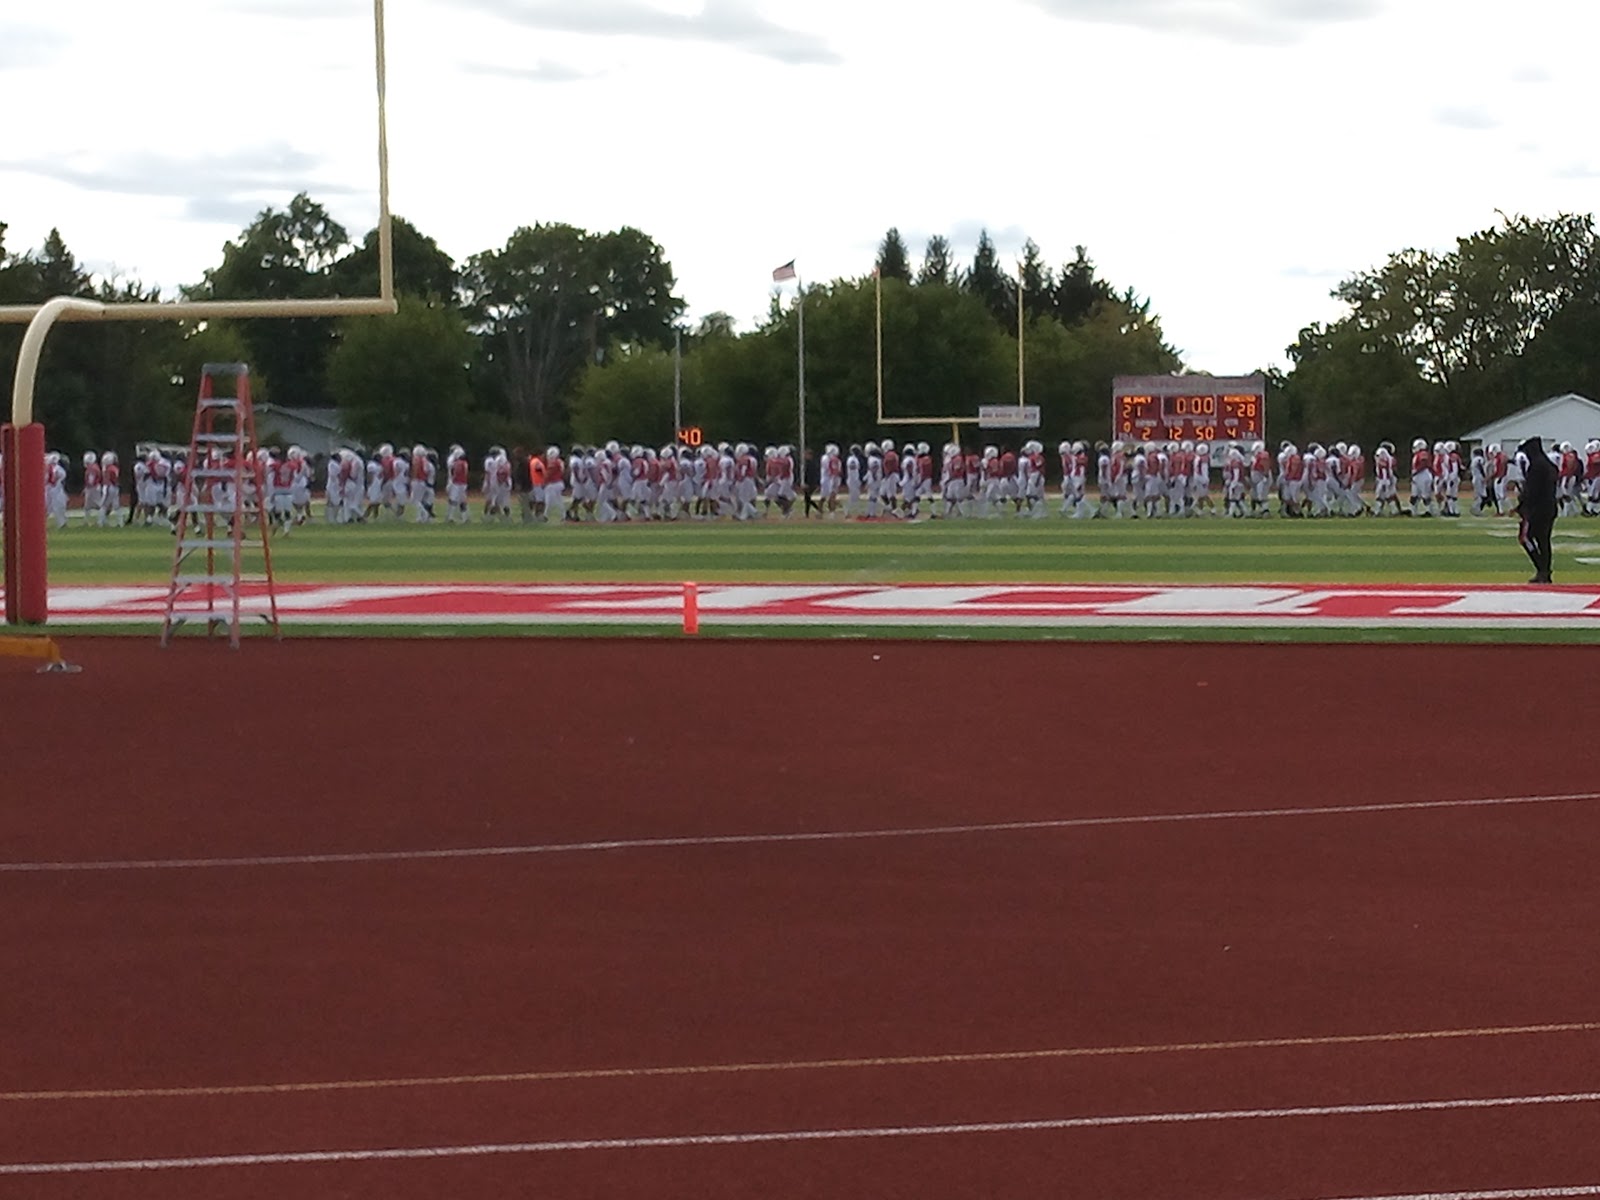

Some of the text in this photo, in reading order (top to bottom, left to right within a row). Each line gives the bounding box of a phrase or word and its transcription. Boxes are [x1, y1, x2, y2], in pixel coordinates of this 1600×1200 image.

[1122, 404, 1141, 418] 21
[1237, 403, 1256, 417] 28
[1123, 421, 1131, 432] 0
[1142, 427, 1151, 440] 2
[1169, 426, 1183, 440] 12
[1195, 426, 1214, 440] 50
[1227, 428, 1237, 438] 4
[678, 429, 701, 445] 40
